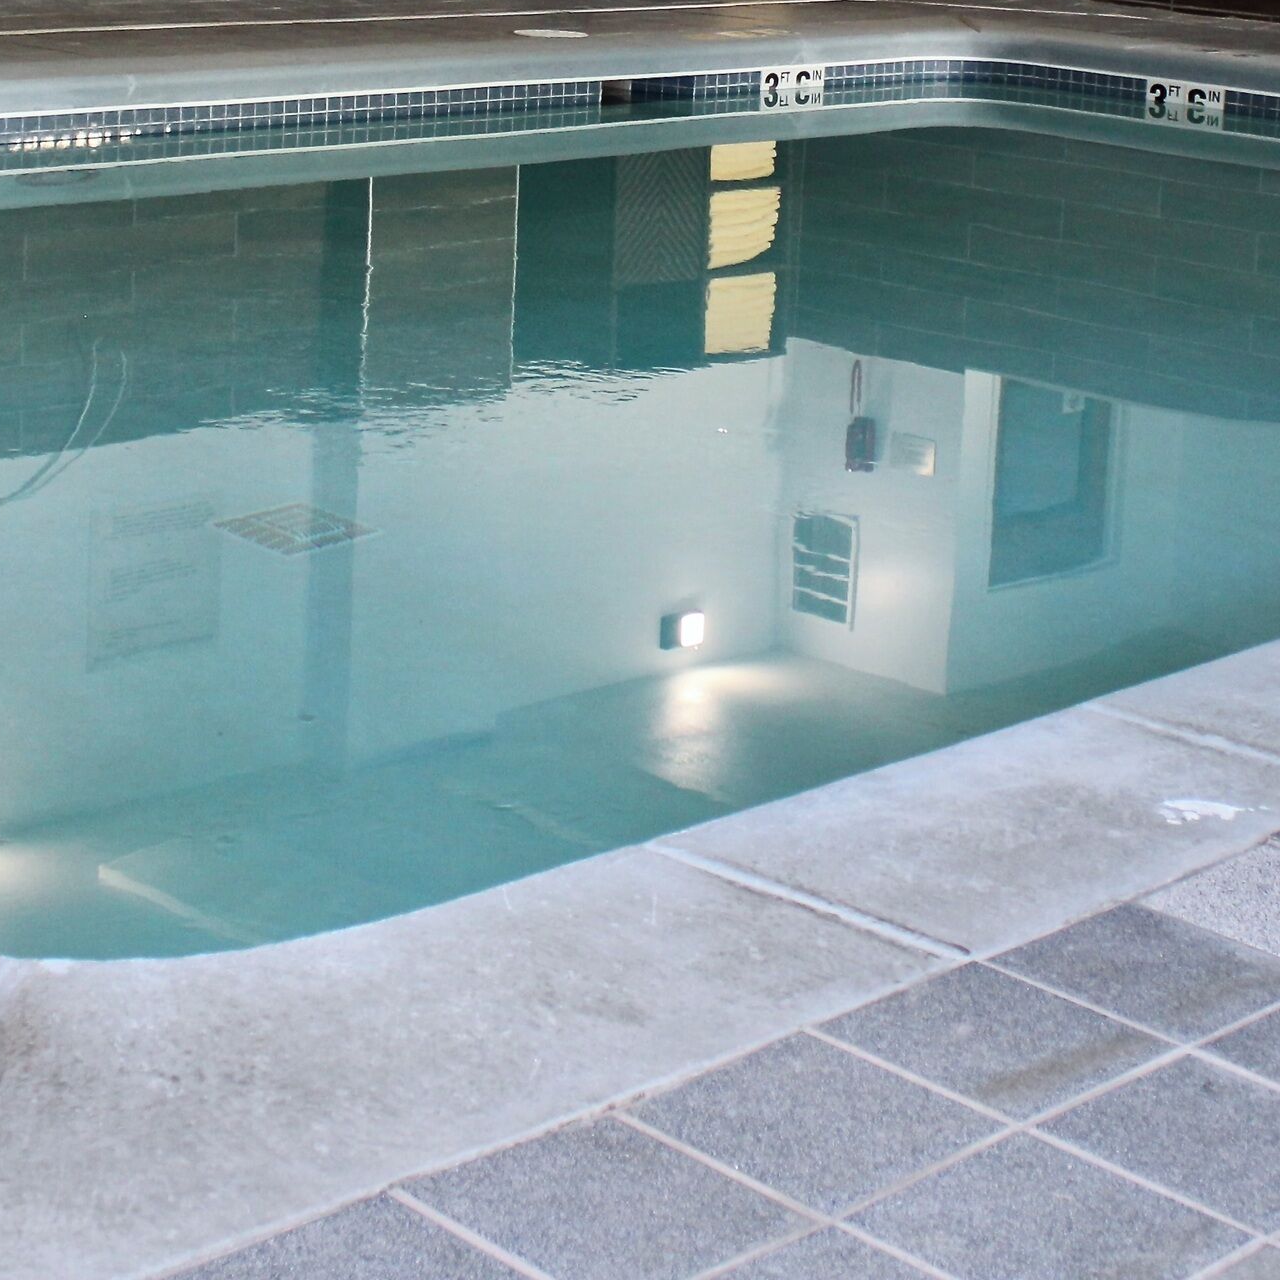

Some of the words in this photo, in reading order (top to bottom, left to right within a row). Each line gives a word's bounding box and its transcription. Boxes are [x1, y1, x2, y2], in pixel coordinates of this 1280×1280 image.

[781, 72, 790, 83] FT
[813, 70, 822, 80] IN
[1169, 86, 1181, 97] FT
[1209, 91, 1220, 102] IN
